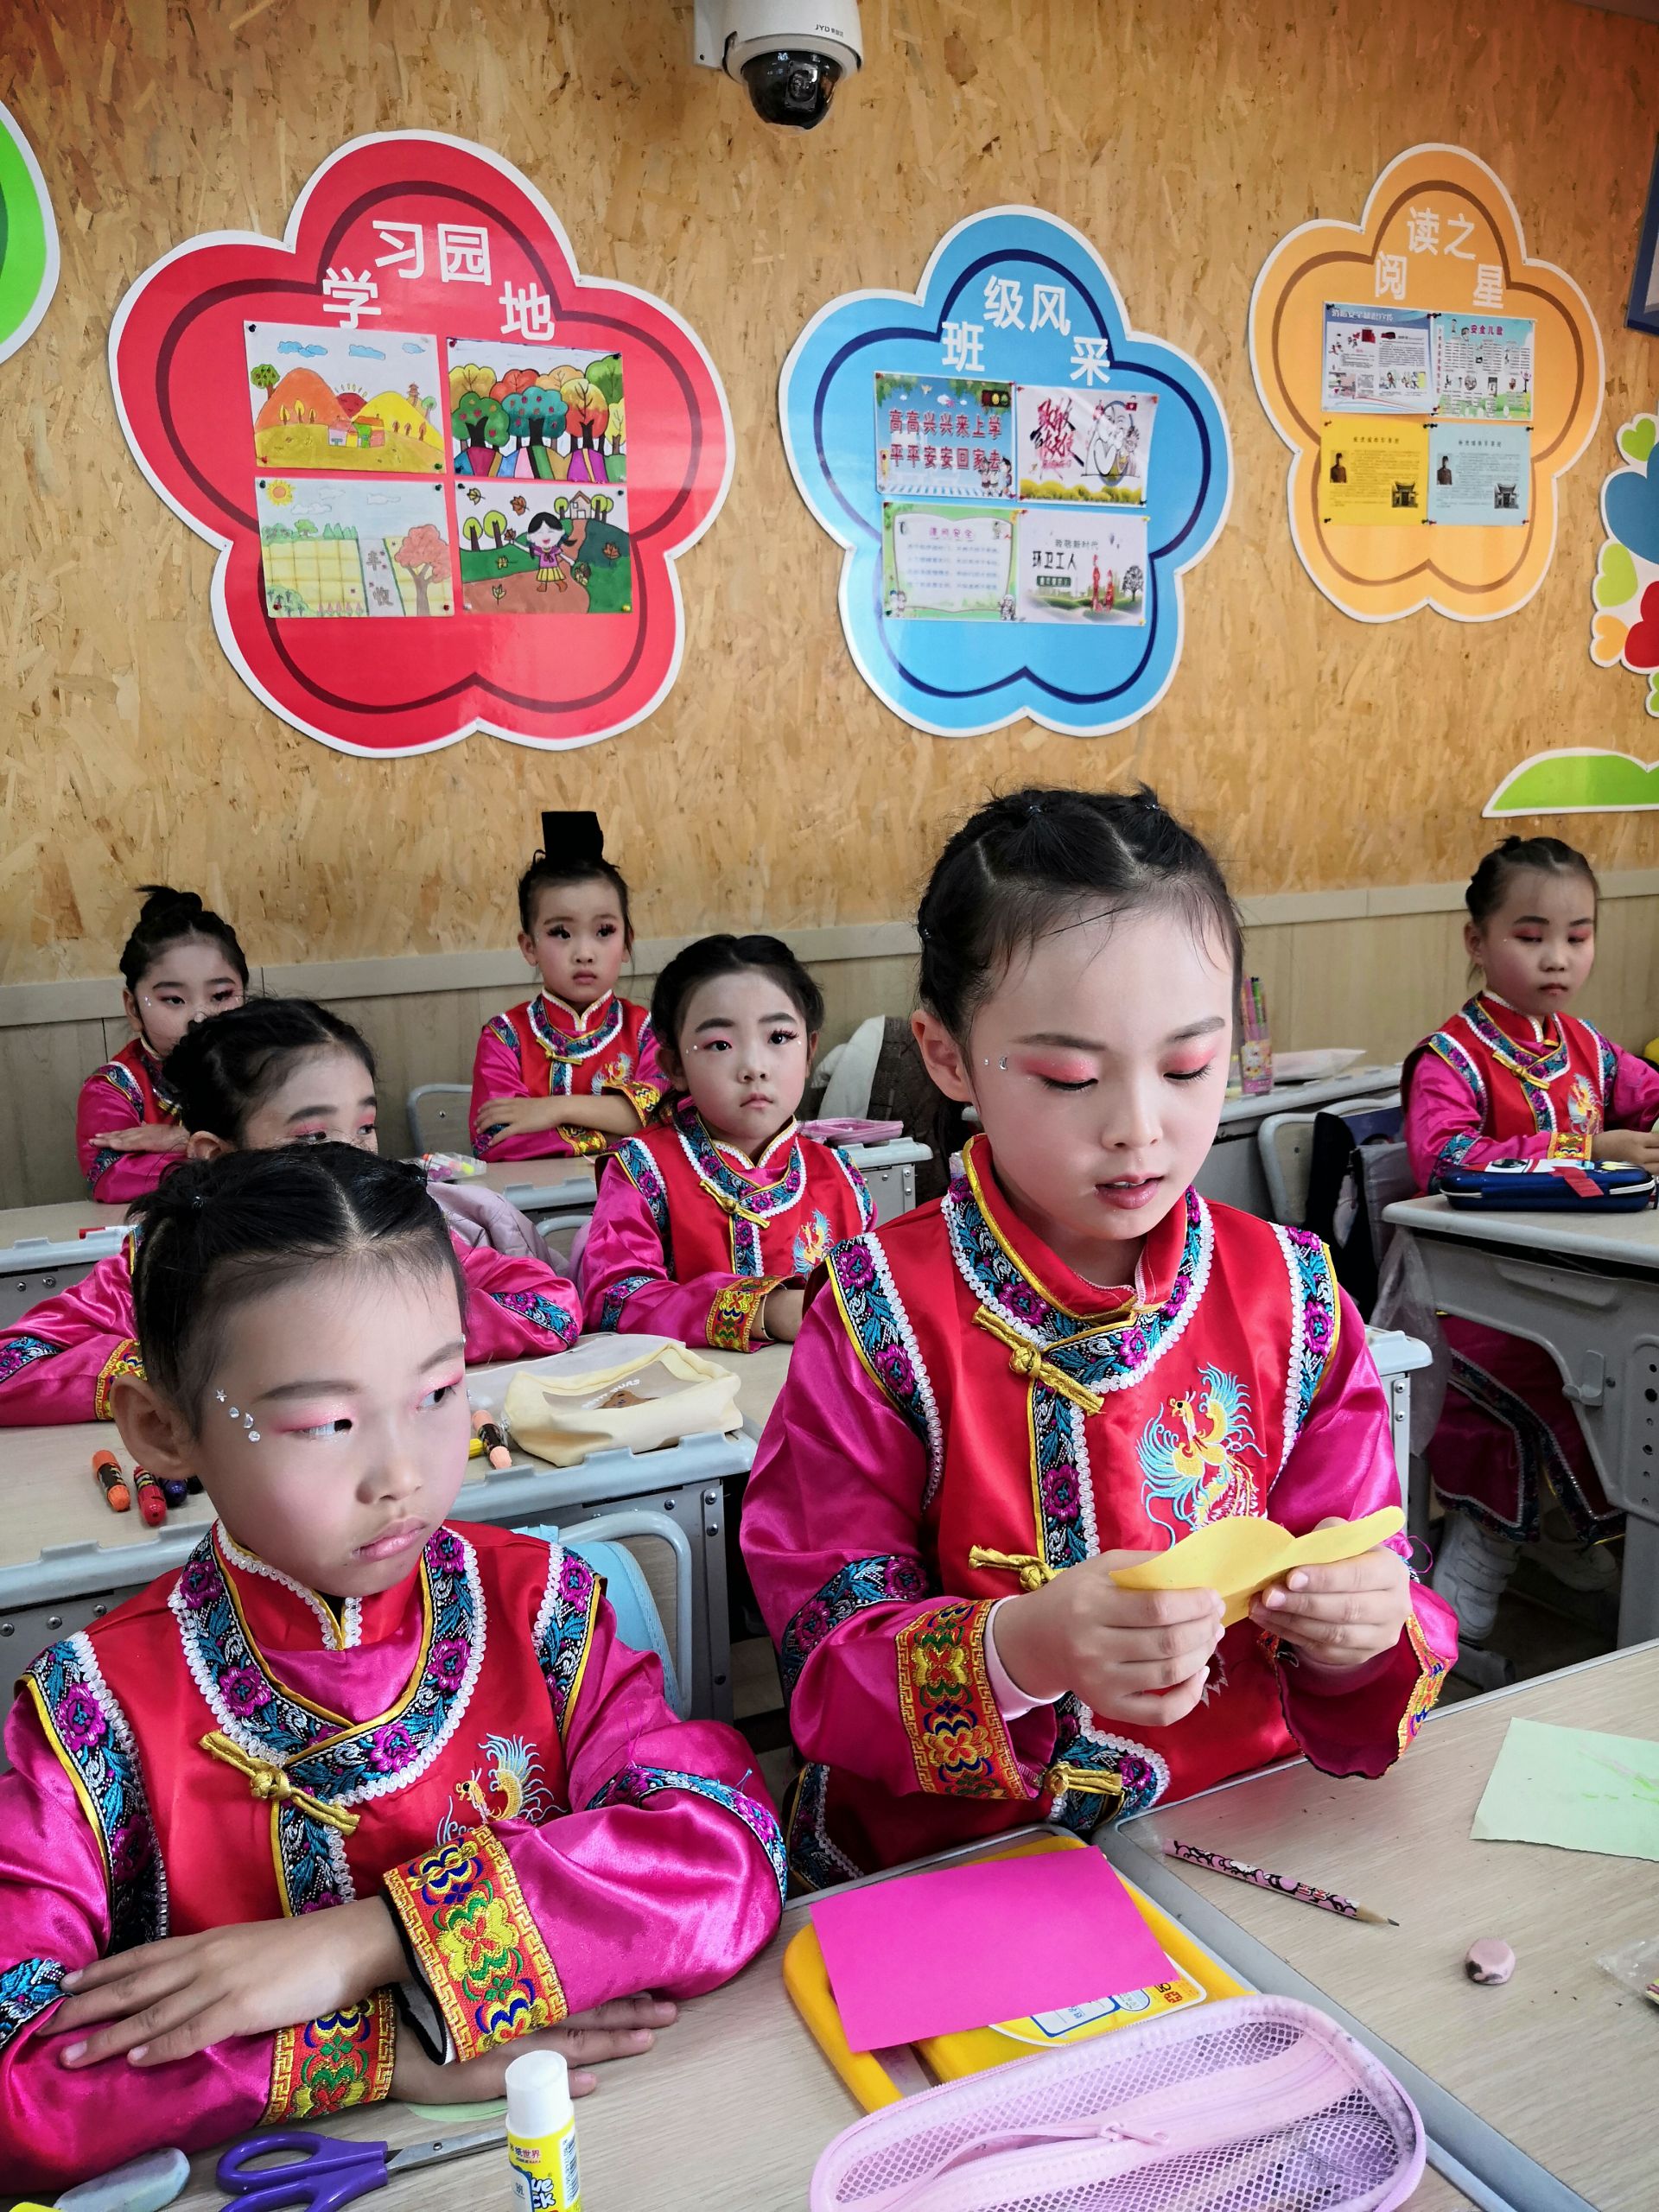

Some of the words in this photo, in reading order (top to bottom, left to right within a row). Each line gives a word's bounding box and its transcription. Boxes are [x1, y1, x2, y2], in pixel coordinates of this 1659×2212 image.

[322, 220, 555, 340] 学习园地
[1375, 207, 1504, 309] 阅读之星
[941, 276, 1111, 386] 班级风采
[888, 409, 1002, 440] 高高兴兴来上学
[890, 443, 1001, 471] 平平安安回家去
[1033, 550, 1077, 571] 环卫工人
